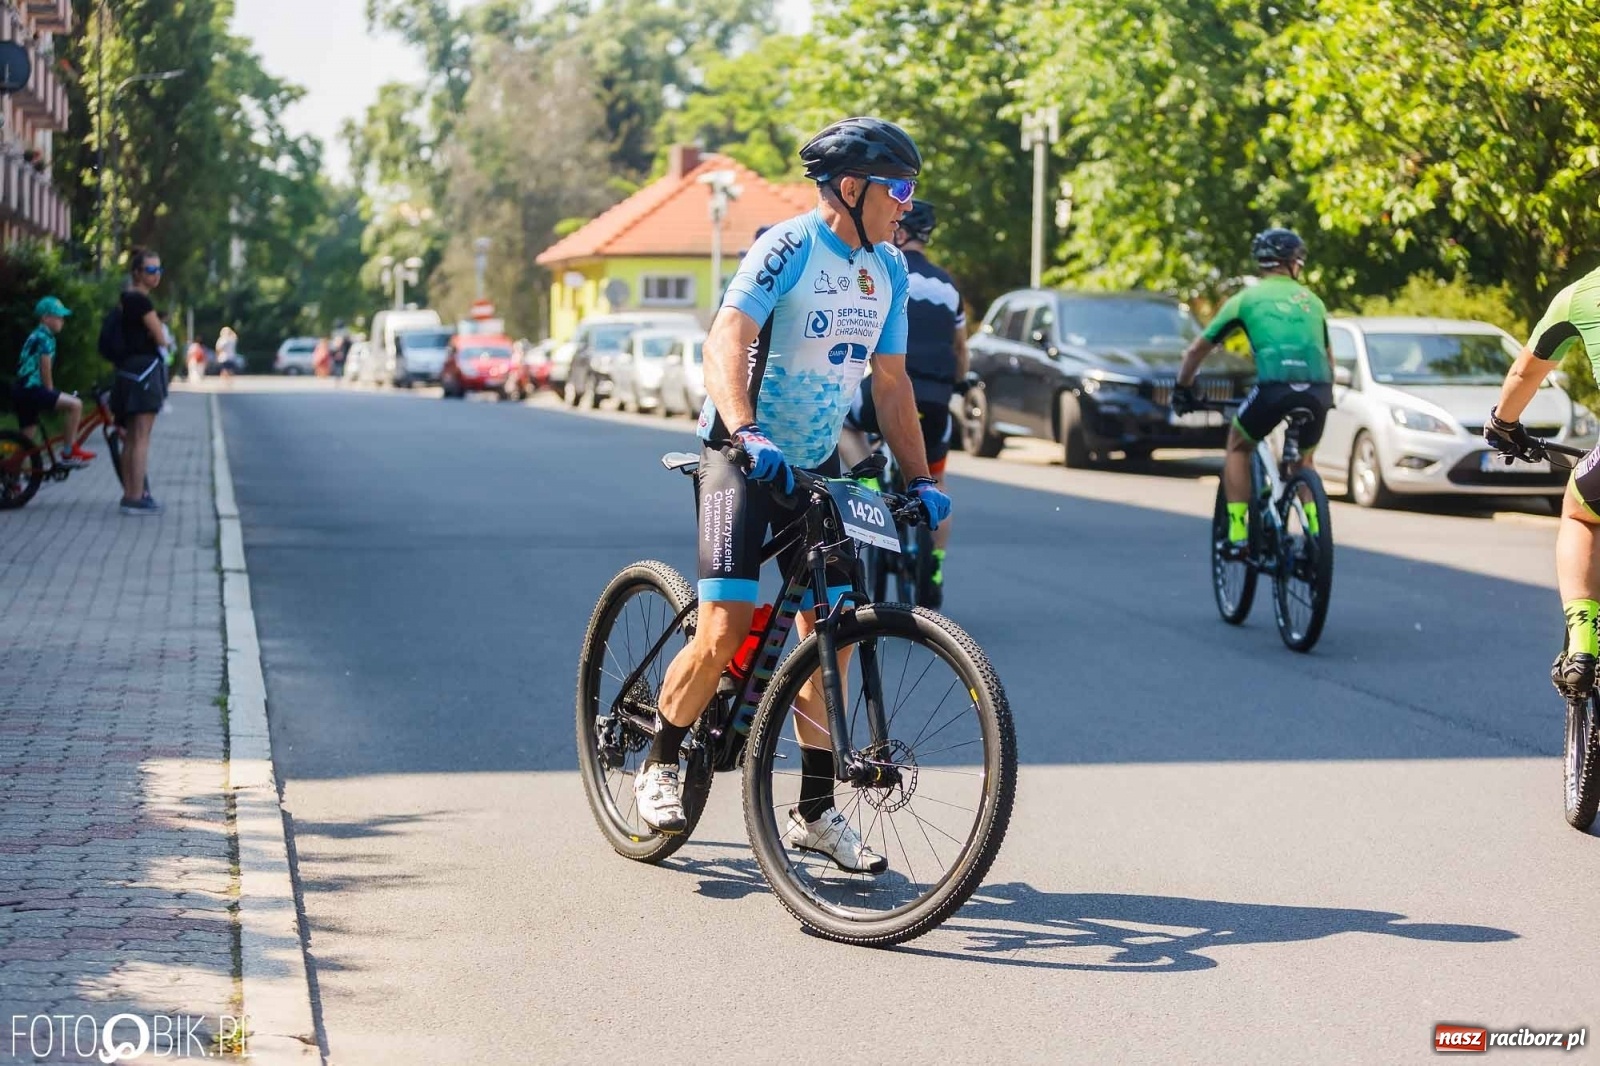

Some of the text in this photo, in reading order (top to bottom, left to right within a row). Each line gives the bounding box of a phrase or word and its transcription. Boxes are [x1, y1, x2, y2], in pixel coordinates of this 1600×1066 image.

[756, 232, 802, 291] SCHC
[837, 308, 877, 319] SEPPELER
[704, 493, 713, 542] Cyklistów
[712, 491, 723, 570] Chrzanowskich
[724, 488, 735, 572] Stowarzyszenie
[848, 499, 885, 527] 1420
[753, 674, 790, 758] CONTINENTAL
